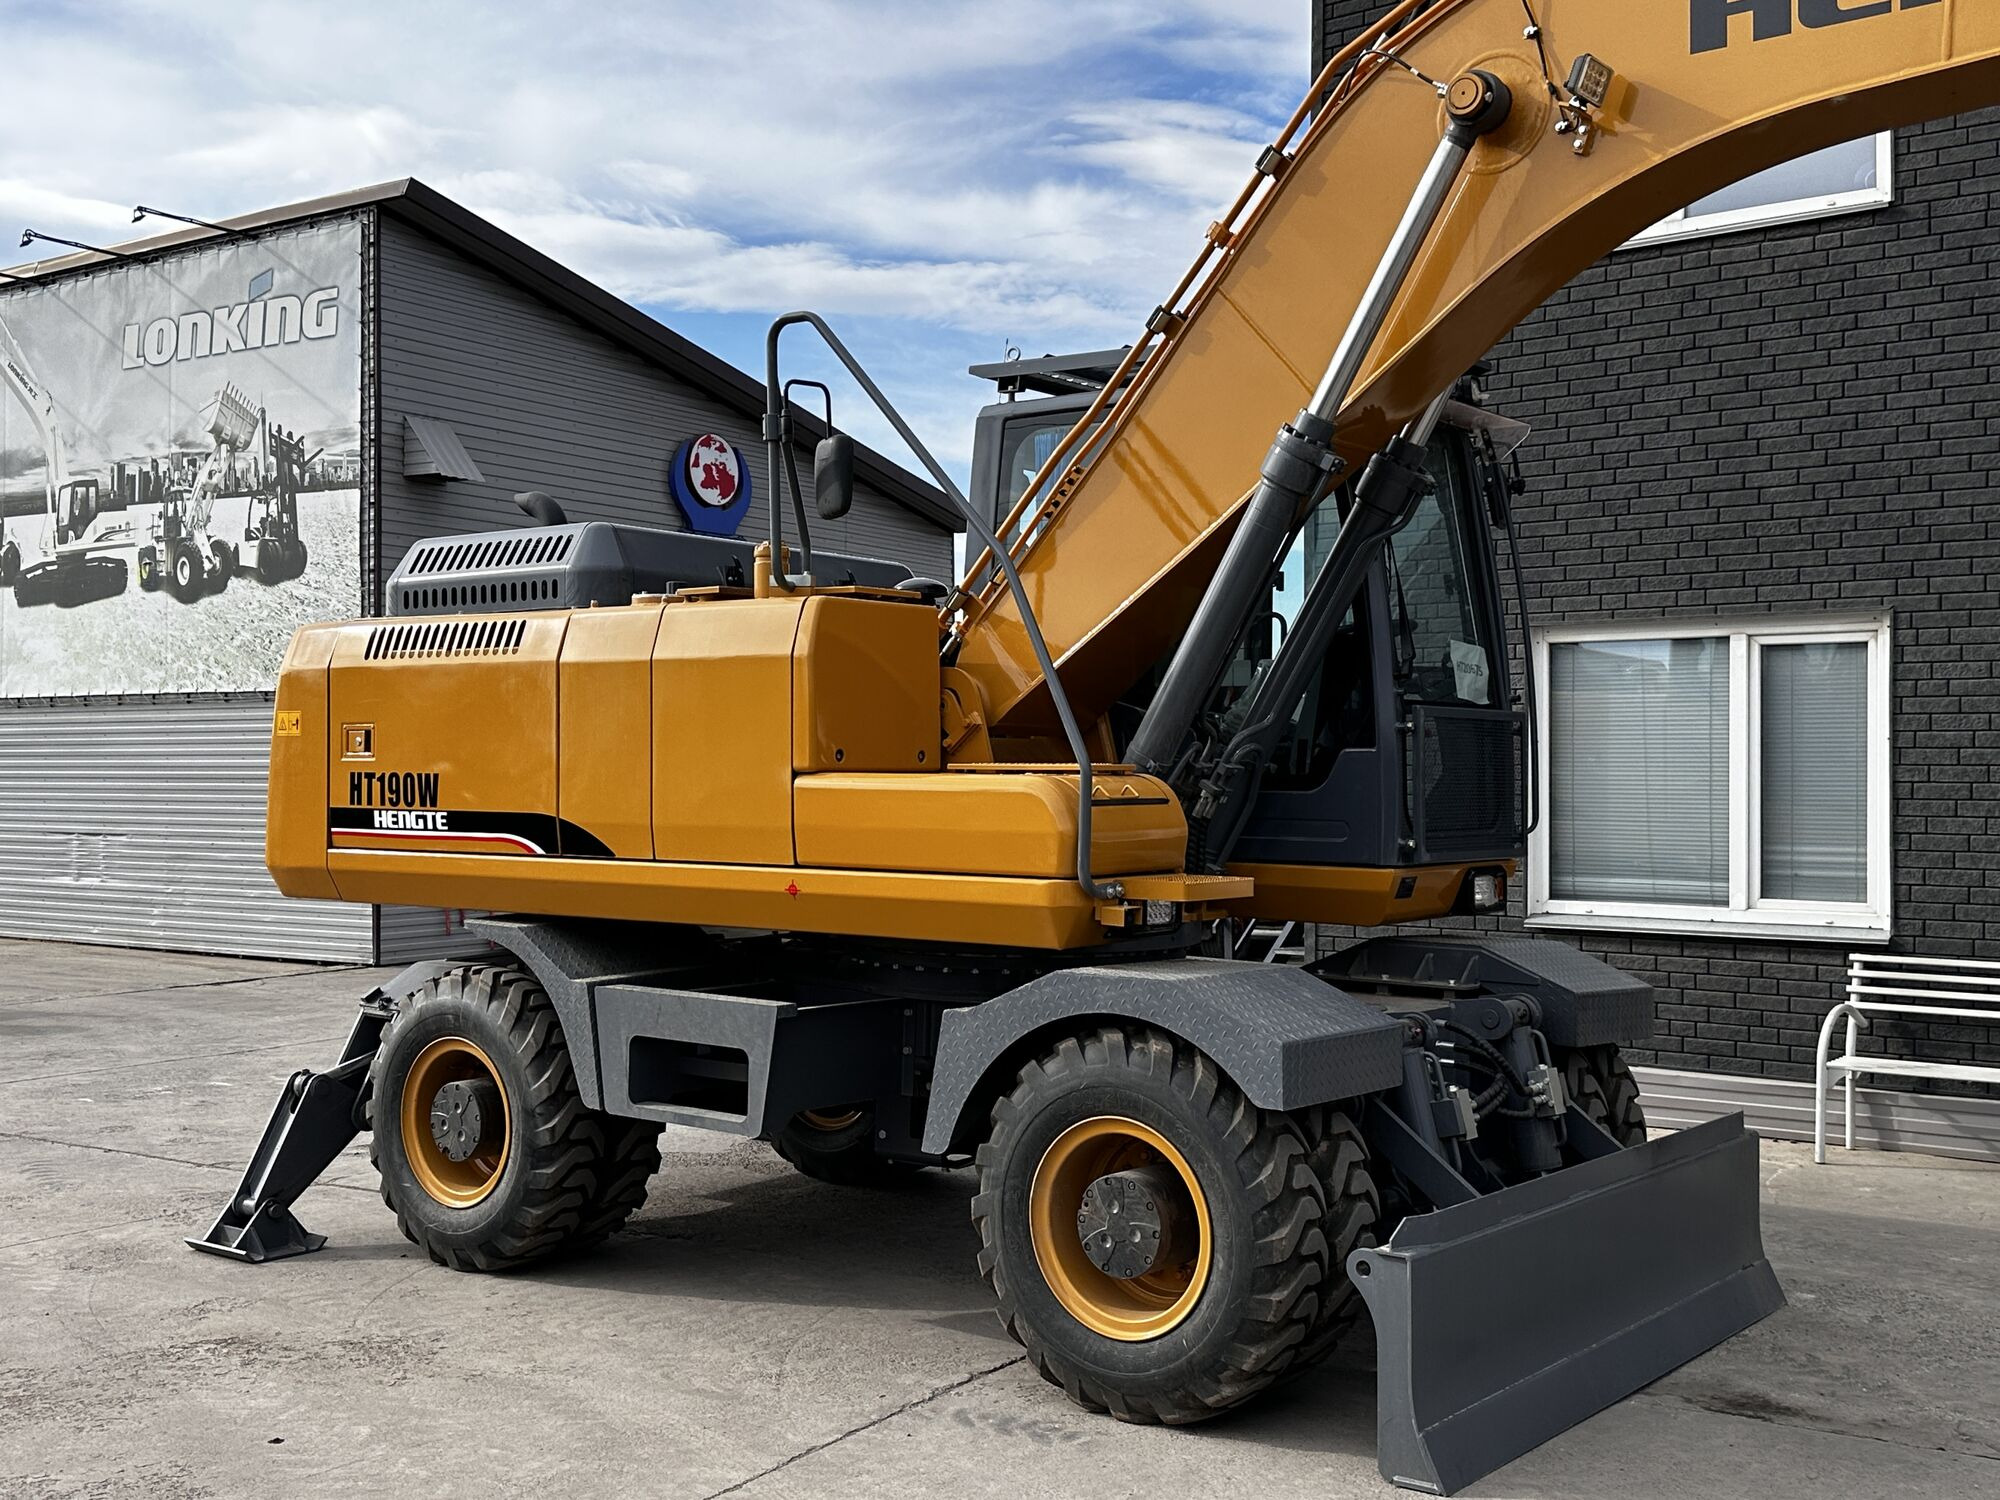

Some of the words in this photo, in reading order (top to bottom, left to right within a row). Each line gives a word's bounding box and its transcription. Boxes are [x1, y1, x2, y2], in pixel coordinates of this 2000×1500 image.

[122, 268, 339, 370] LONKING
[349, 771, 439, 808] HT190W
[373, 810, 448, 830] HENGTE
